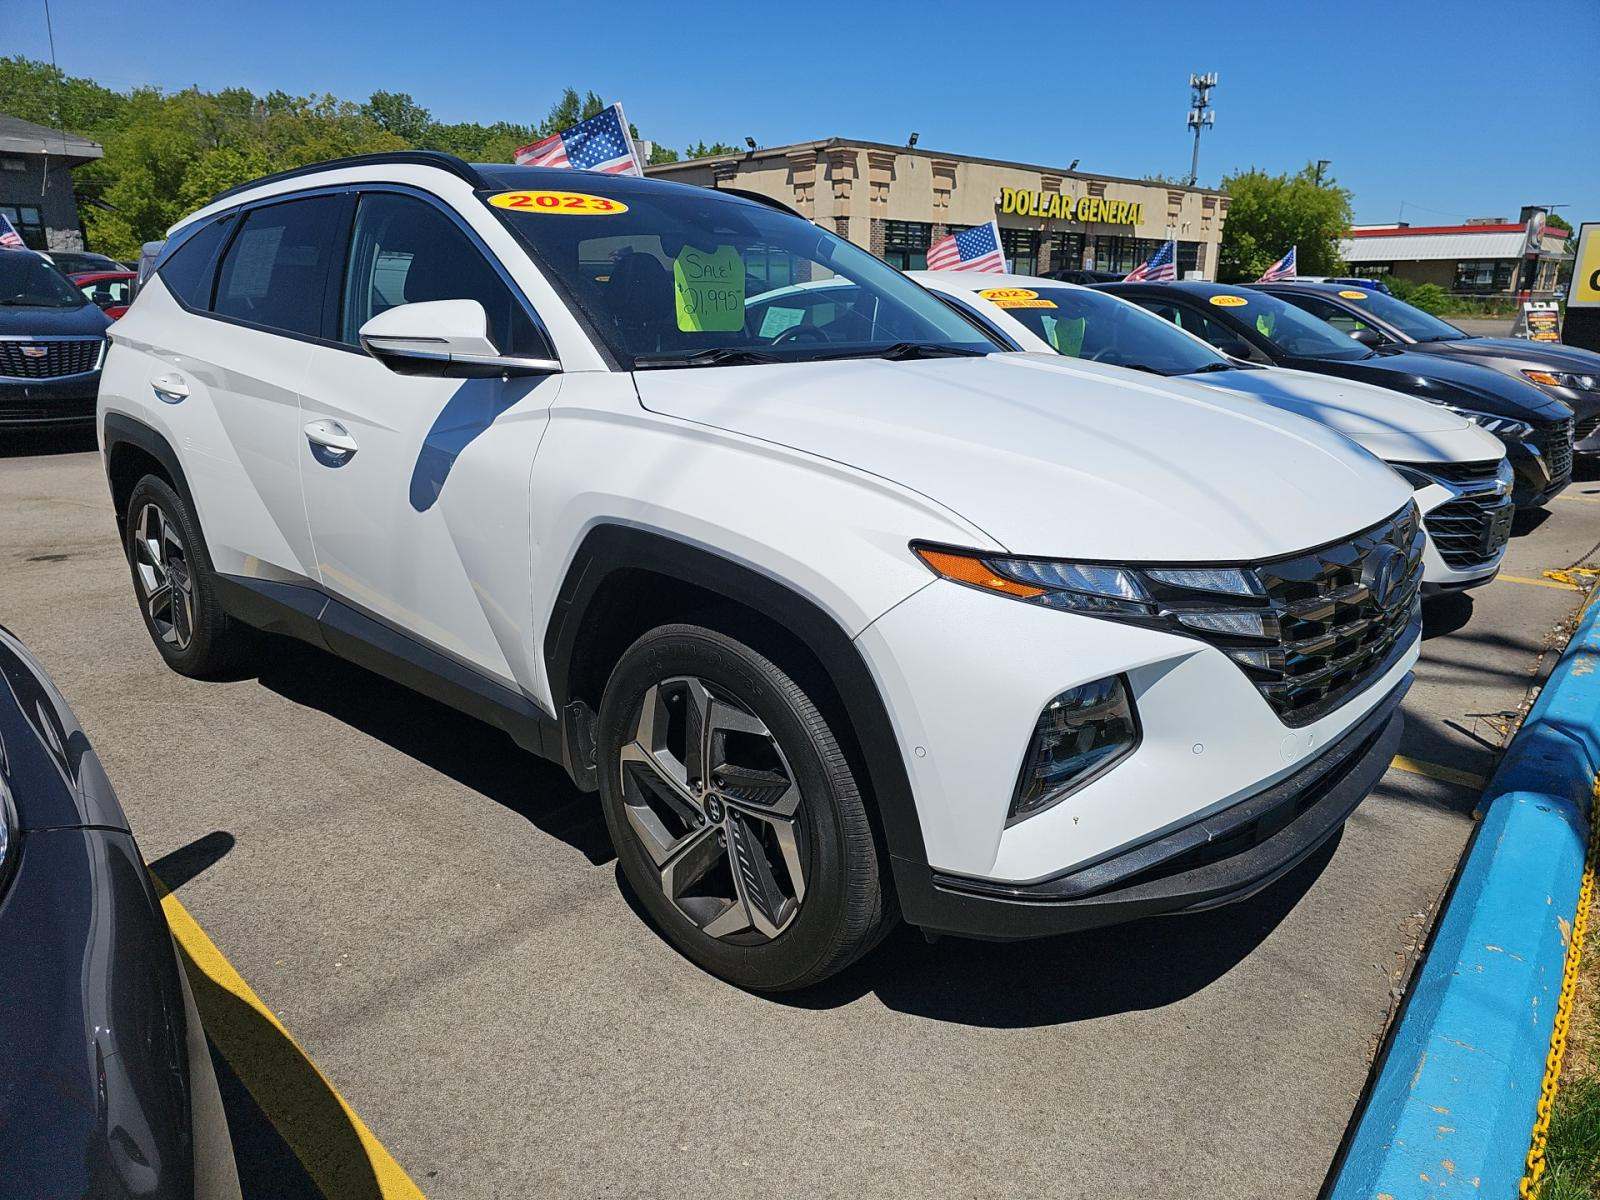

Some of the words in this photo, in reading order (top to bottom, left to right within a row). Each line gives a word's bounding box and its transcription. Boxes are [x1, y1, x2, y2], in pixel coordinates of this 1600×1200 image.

[508, 195, 614, 211] 2023
[1002, 187, 1073, 220] DOLLAR
[1076, 196, 1145, 224] GENERAL
